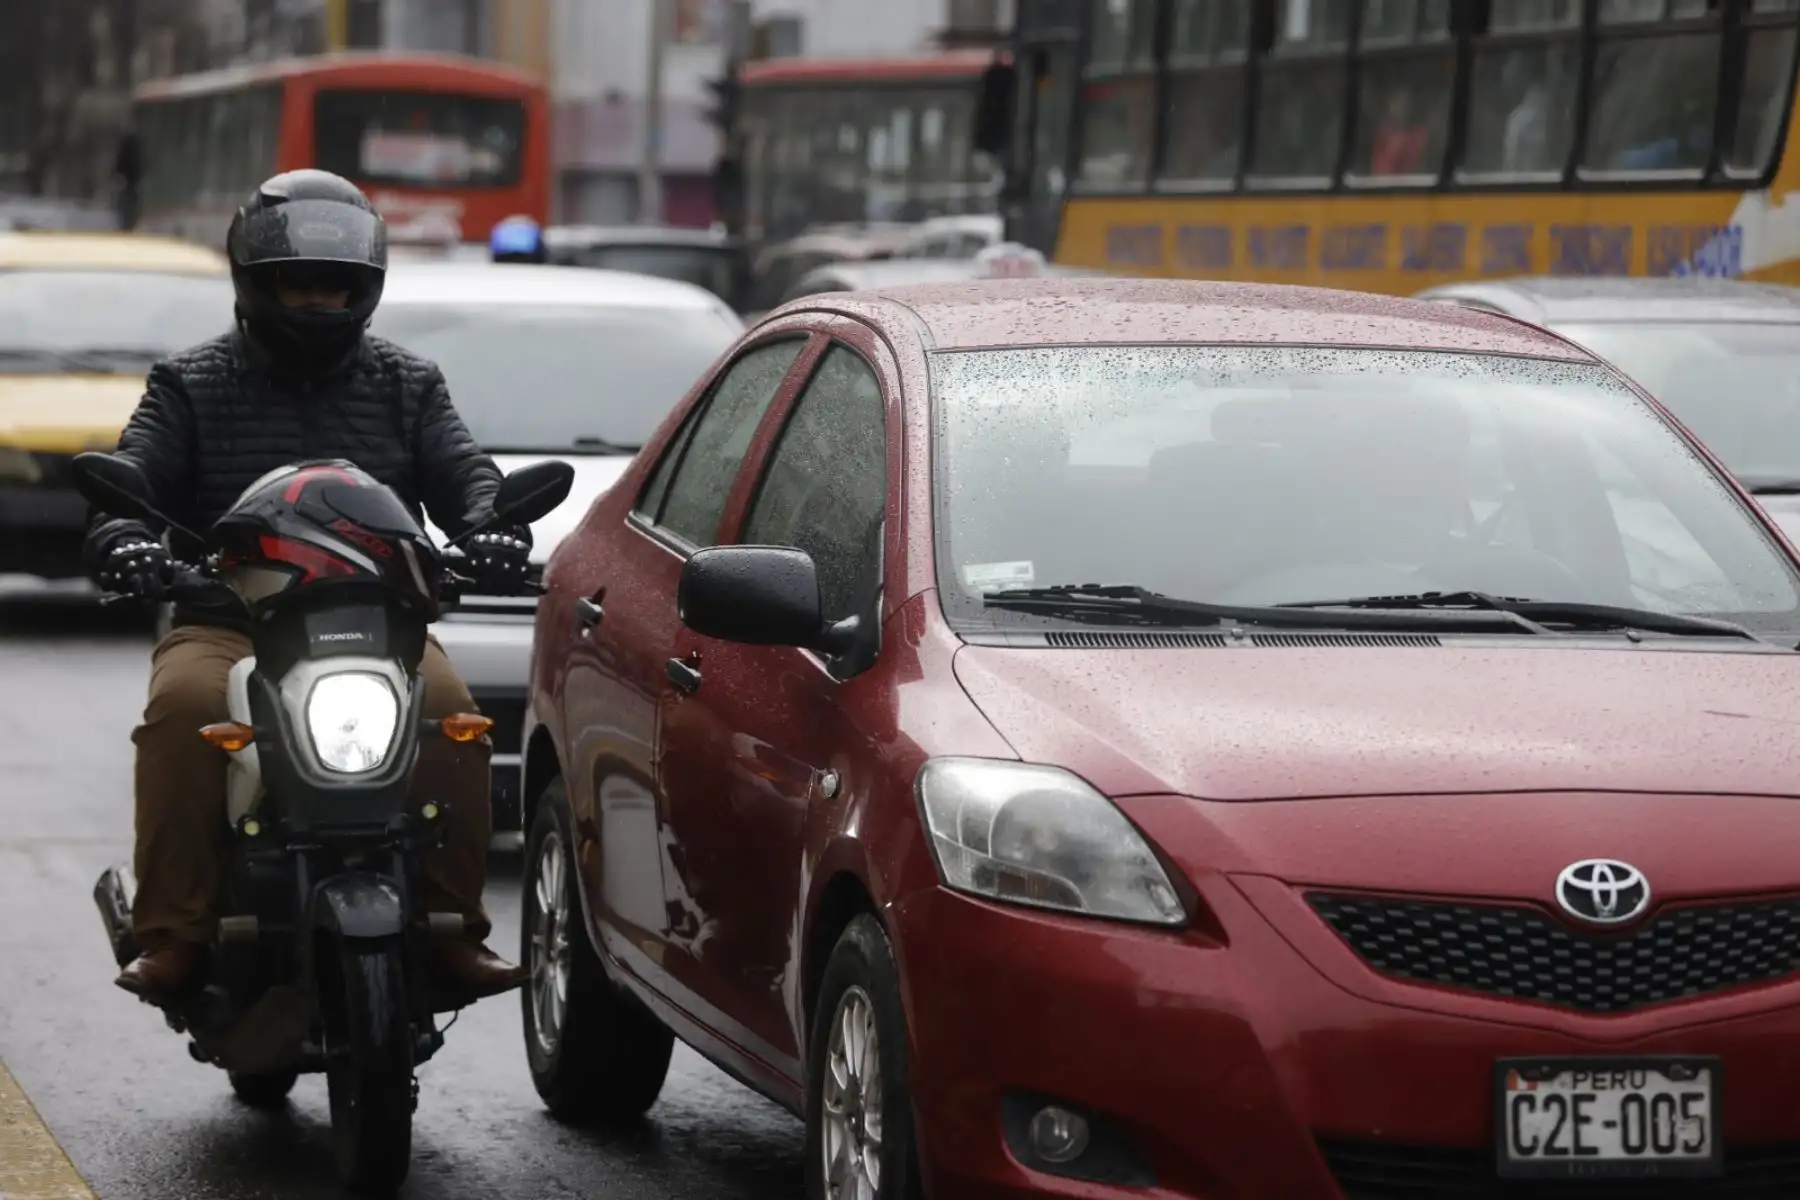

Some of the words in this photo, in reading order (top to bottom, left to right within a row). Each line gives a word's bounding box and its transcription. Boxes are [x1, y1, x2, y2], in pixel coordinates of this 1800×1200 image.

[319, 632, 364, 641] HONDA
[1572, 1070, 1647, 1090] PERU
[1512, 1092, 1705, 1156] C2E-005
